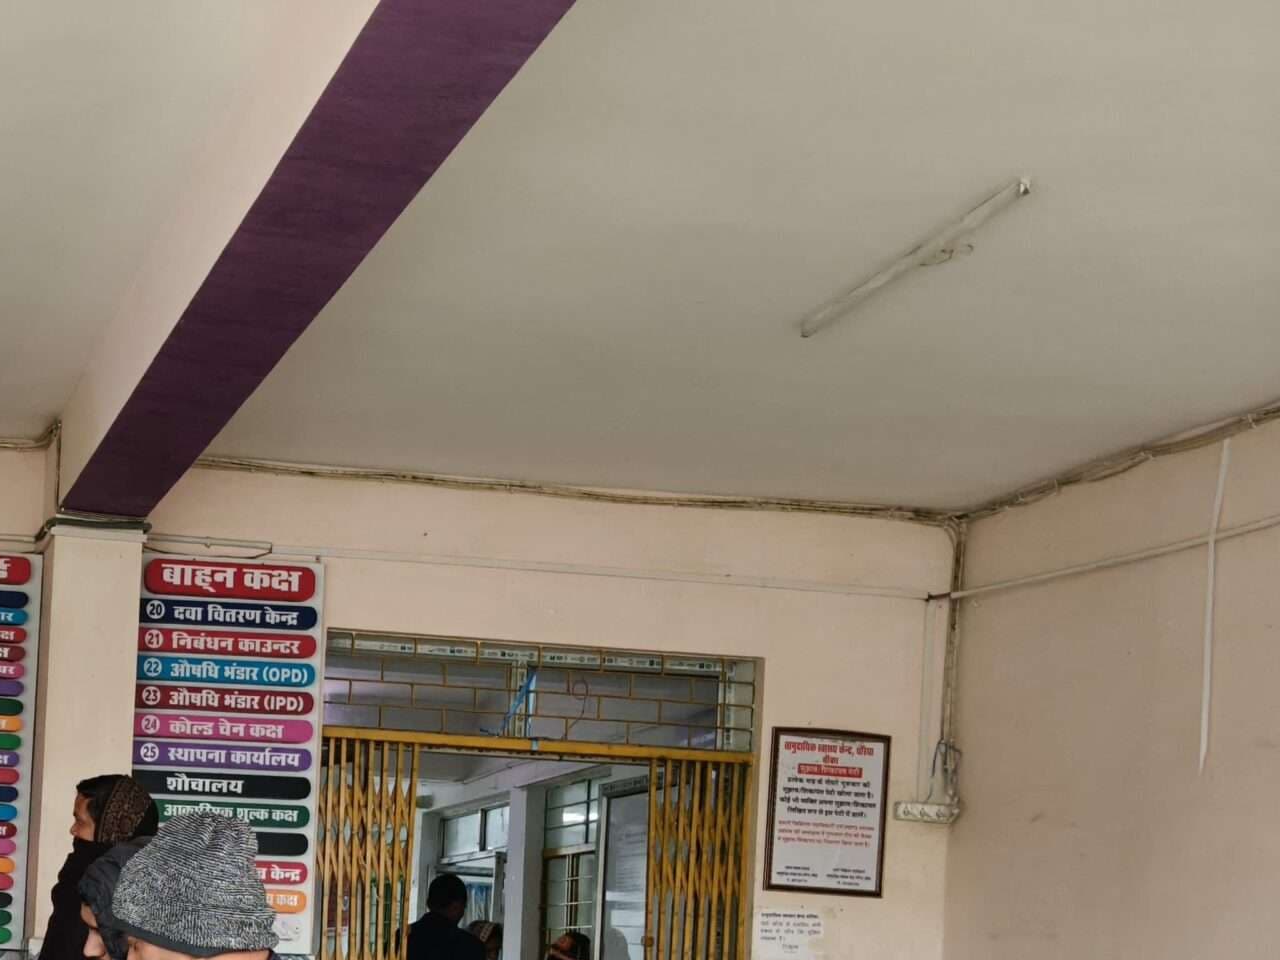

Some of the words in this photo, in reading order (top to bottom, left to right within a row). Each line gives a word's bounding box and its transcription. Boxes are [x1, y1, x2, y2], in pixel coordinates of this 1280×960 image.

[242, 568, 303, 592] कक्ष
[173, 606, 204, 622] दवा
[207, 604, 262, 624] वितरण
[264, 606, 300, 626] केन्द्र
[171, 631, 235, 651] निबंधन
[238, 638, 301, 654] काउन्टर
[170, 660, 221, 678] औषधि
[223, 663, 260, 681] भंडार
[262, 666, 308, 684] (OPD)
[169, 686, 221, 707] औषधि
[223, 691, 261, 710] भंडार
[264, 693, 305, 712] (IPD)
[168, 717, 216, 735] कोल्ड
[219, 718, 246, 737] चेन
[249, 723, 285, 738] कक्ष
[168, 747, 227, 763] स्थापना
[230, 748, 301, 767] कार्यालय
[166, 773, 245, 794] शौचालय
[271, 809, 299, 822] कक्ष
